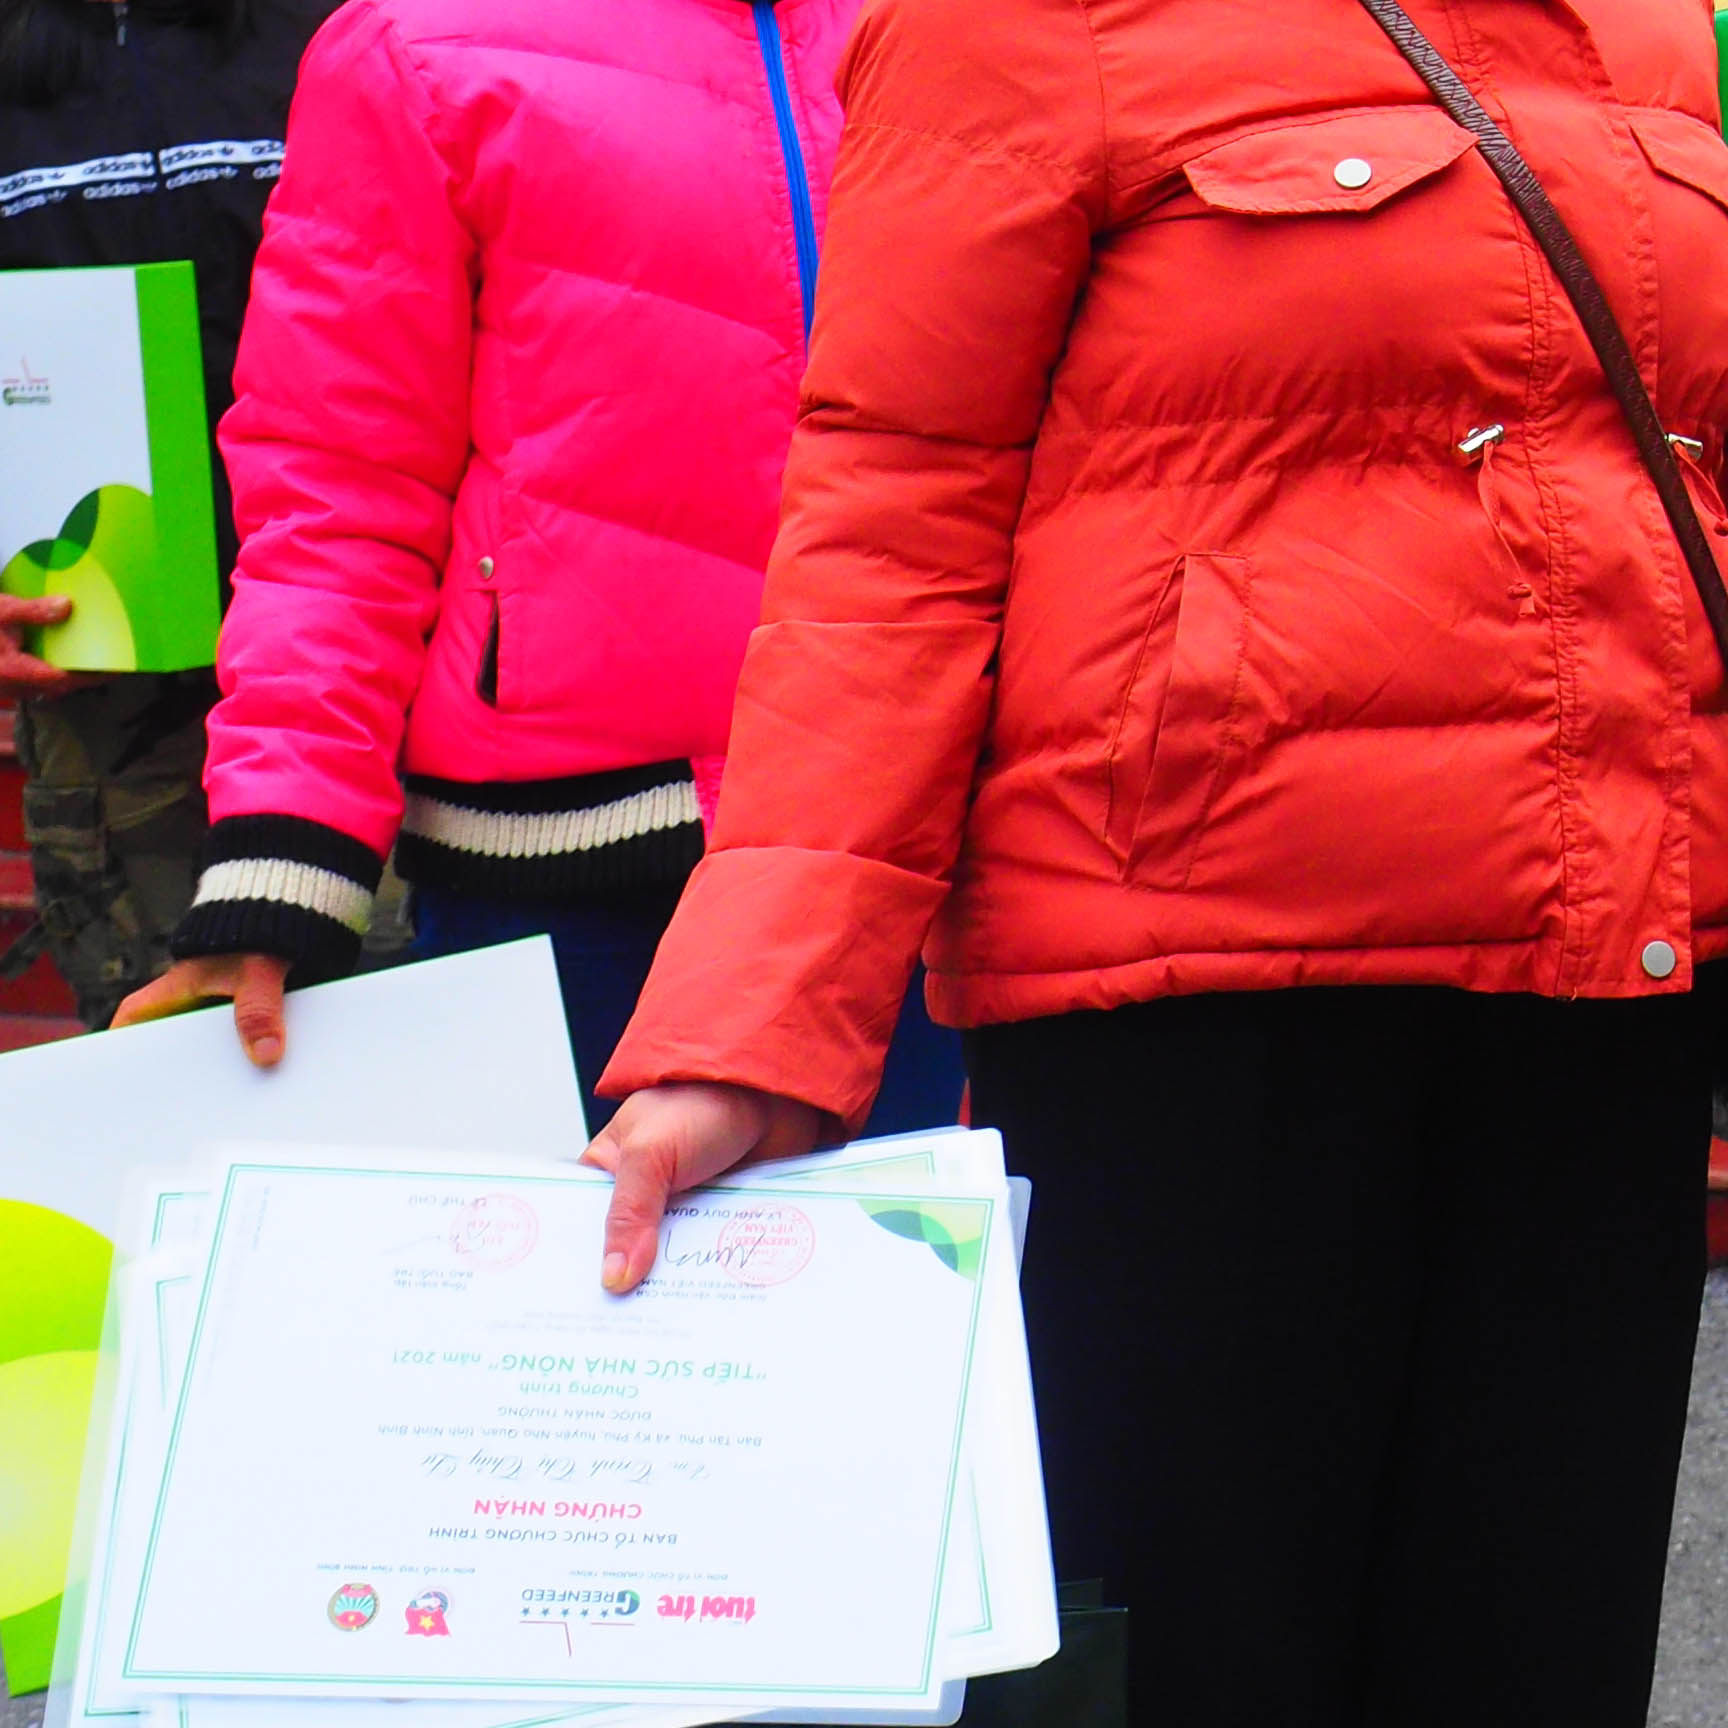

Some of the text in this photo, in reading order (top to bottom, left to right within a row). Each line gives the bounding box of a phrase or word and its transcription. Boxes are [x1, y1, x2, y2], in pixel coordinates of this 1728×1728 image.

[83, 182, 142, 200] adidas
[166, 168, 219, 190] adidas
[391, 1350, 436, 1367] 2021
[583, 1356, 636, 1379] NHÀ
[643, 1359, 694, 1383] SỨC
[472, 1495, 643, 1523] CHỨNG NHẬN
[615, 1531, 635, 1549] TỔ
[642, 1533, 678, 1546] BAN
[521, 1589, 640, 1617] GREENFEED
